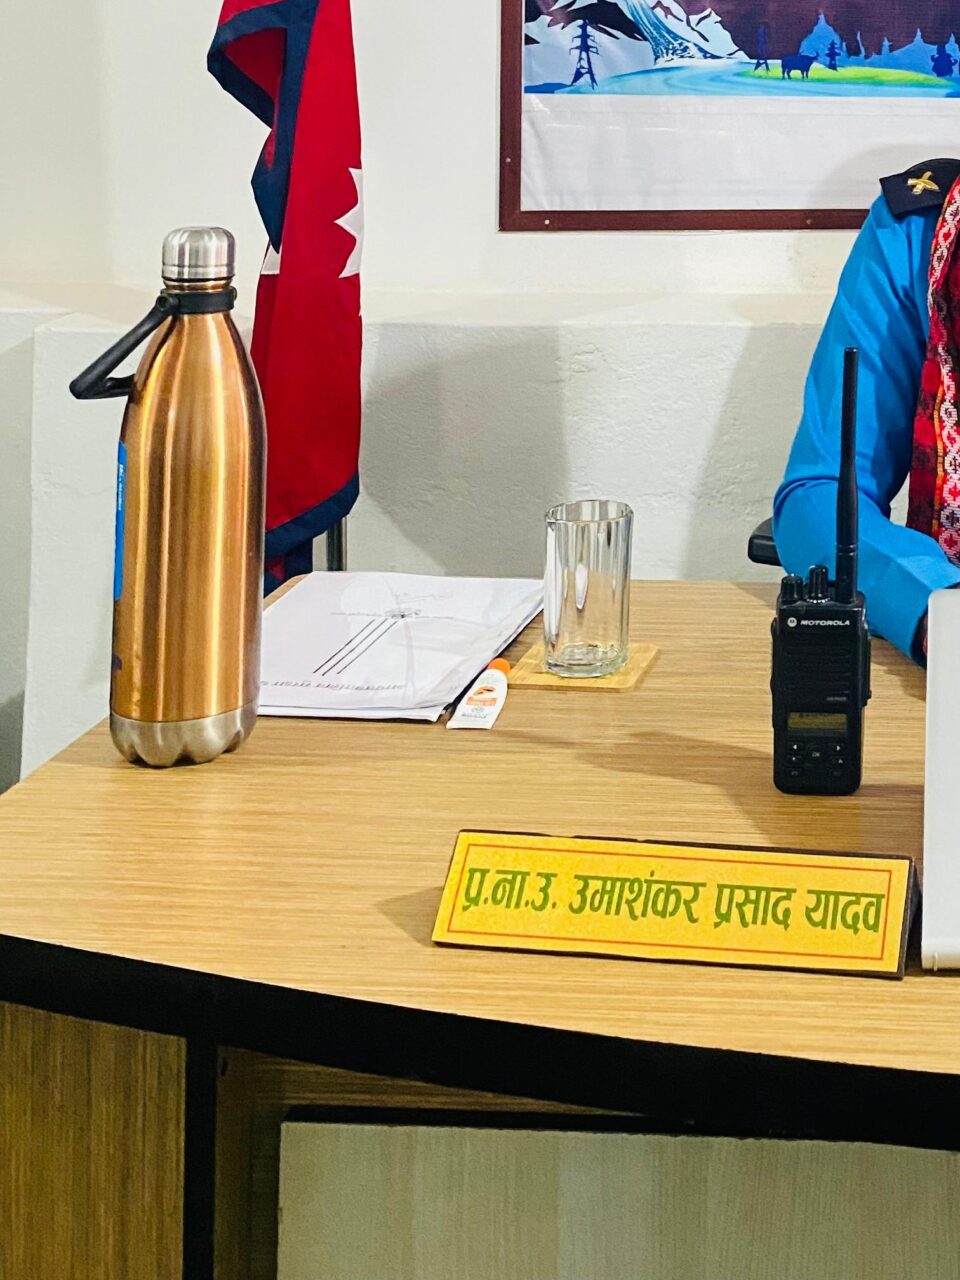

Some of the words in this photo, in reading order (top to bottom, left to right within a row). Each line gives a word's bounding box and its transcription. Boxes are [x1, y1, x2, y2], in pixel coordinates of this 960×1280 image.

[800, 619, 851, 627] MOTOROLA
[569, 870, 708, 924] उमाशंकर
[713, 883, 797, 930] प्रसाद
[804, 889, 886, 936] यादव
